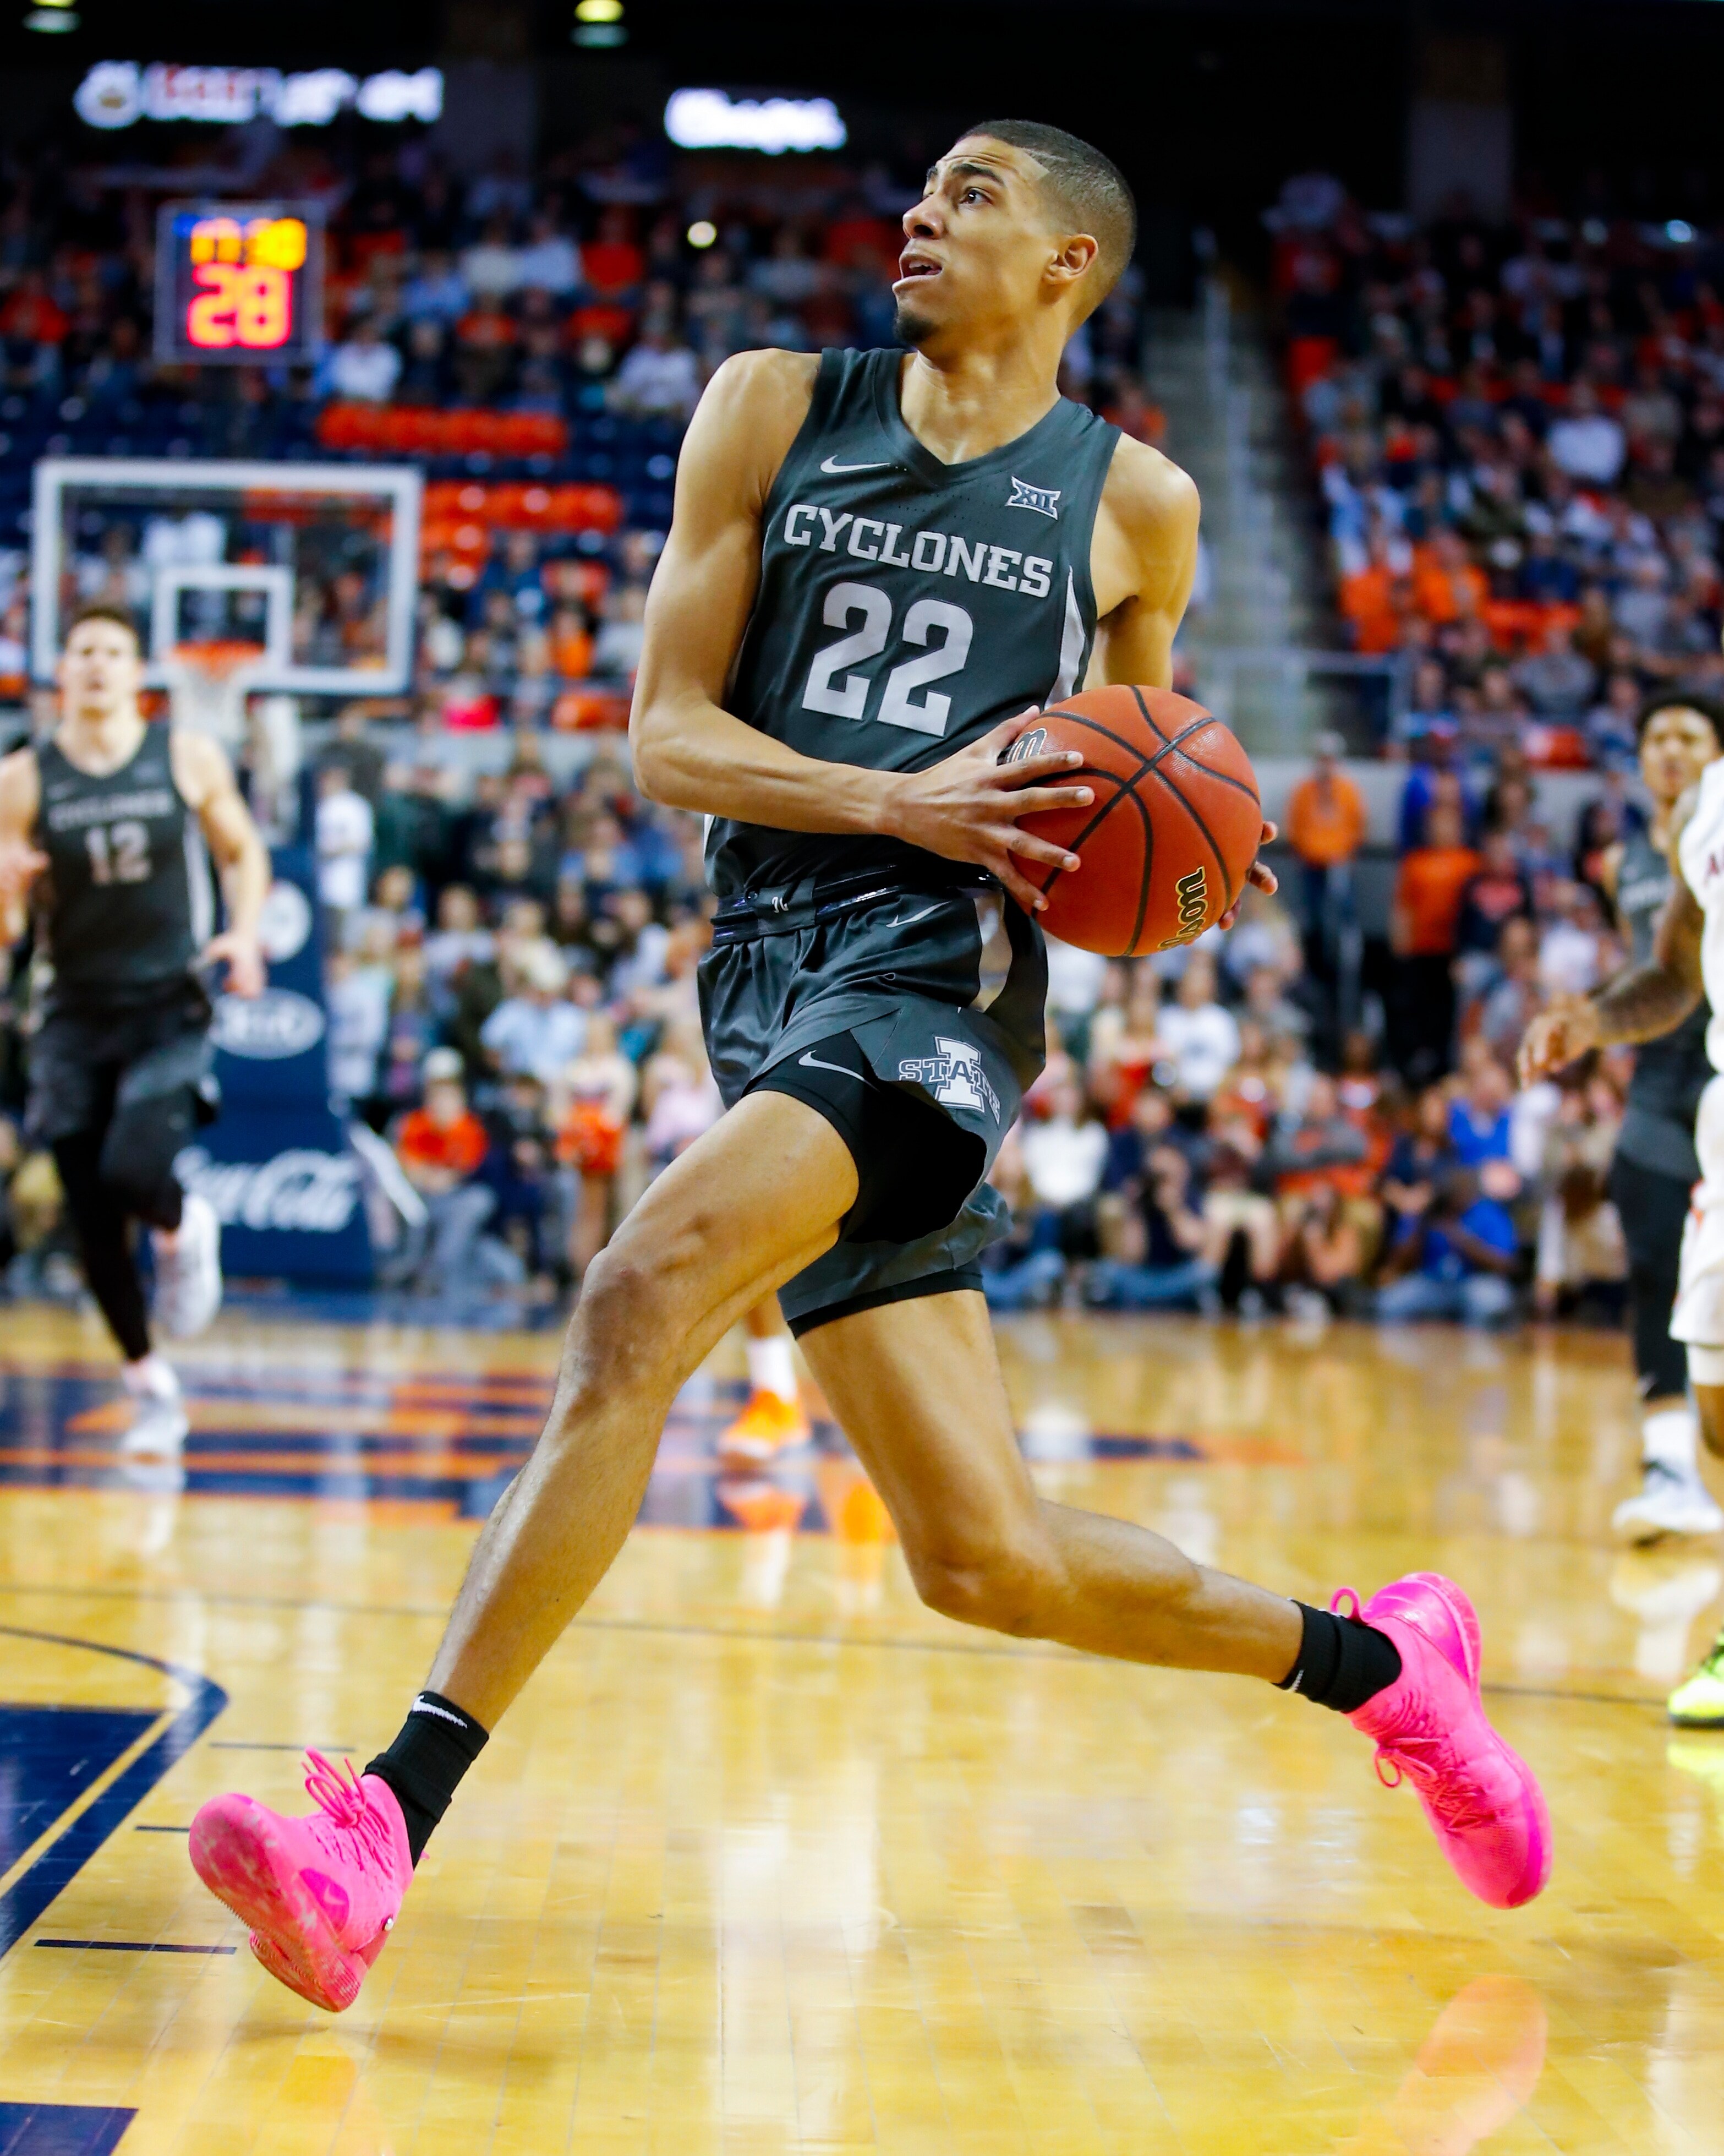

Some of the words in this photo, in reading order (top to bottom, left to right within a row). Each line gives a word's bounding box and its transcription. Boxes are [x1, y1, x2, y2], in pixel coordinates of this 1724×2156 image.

[187, 261, 293, 350] 28
[1005, 476, 1061, 521] XII
[784, 504, 1053, 598] CYCLONES
[801, 581, 973, 738] 22
[84, 820, 153, 887] 12
